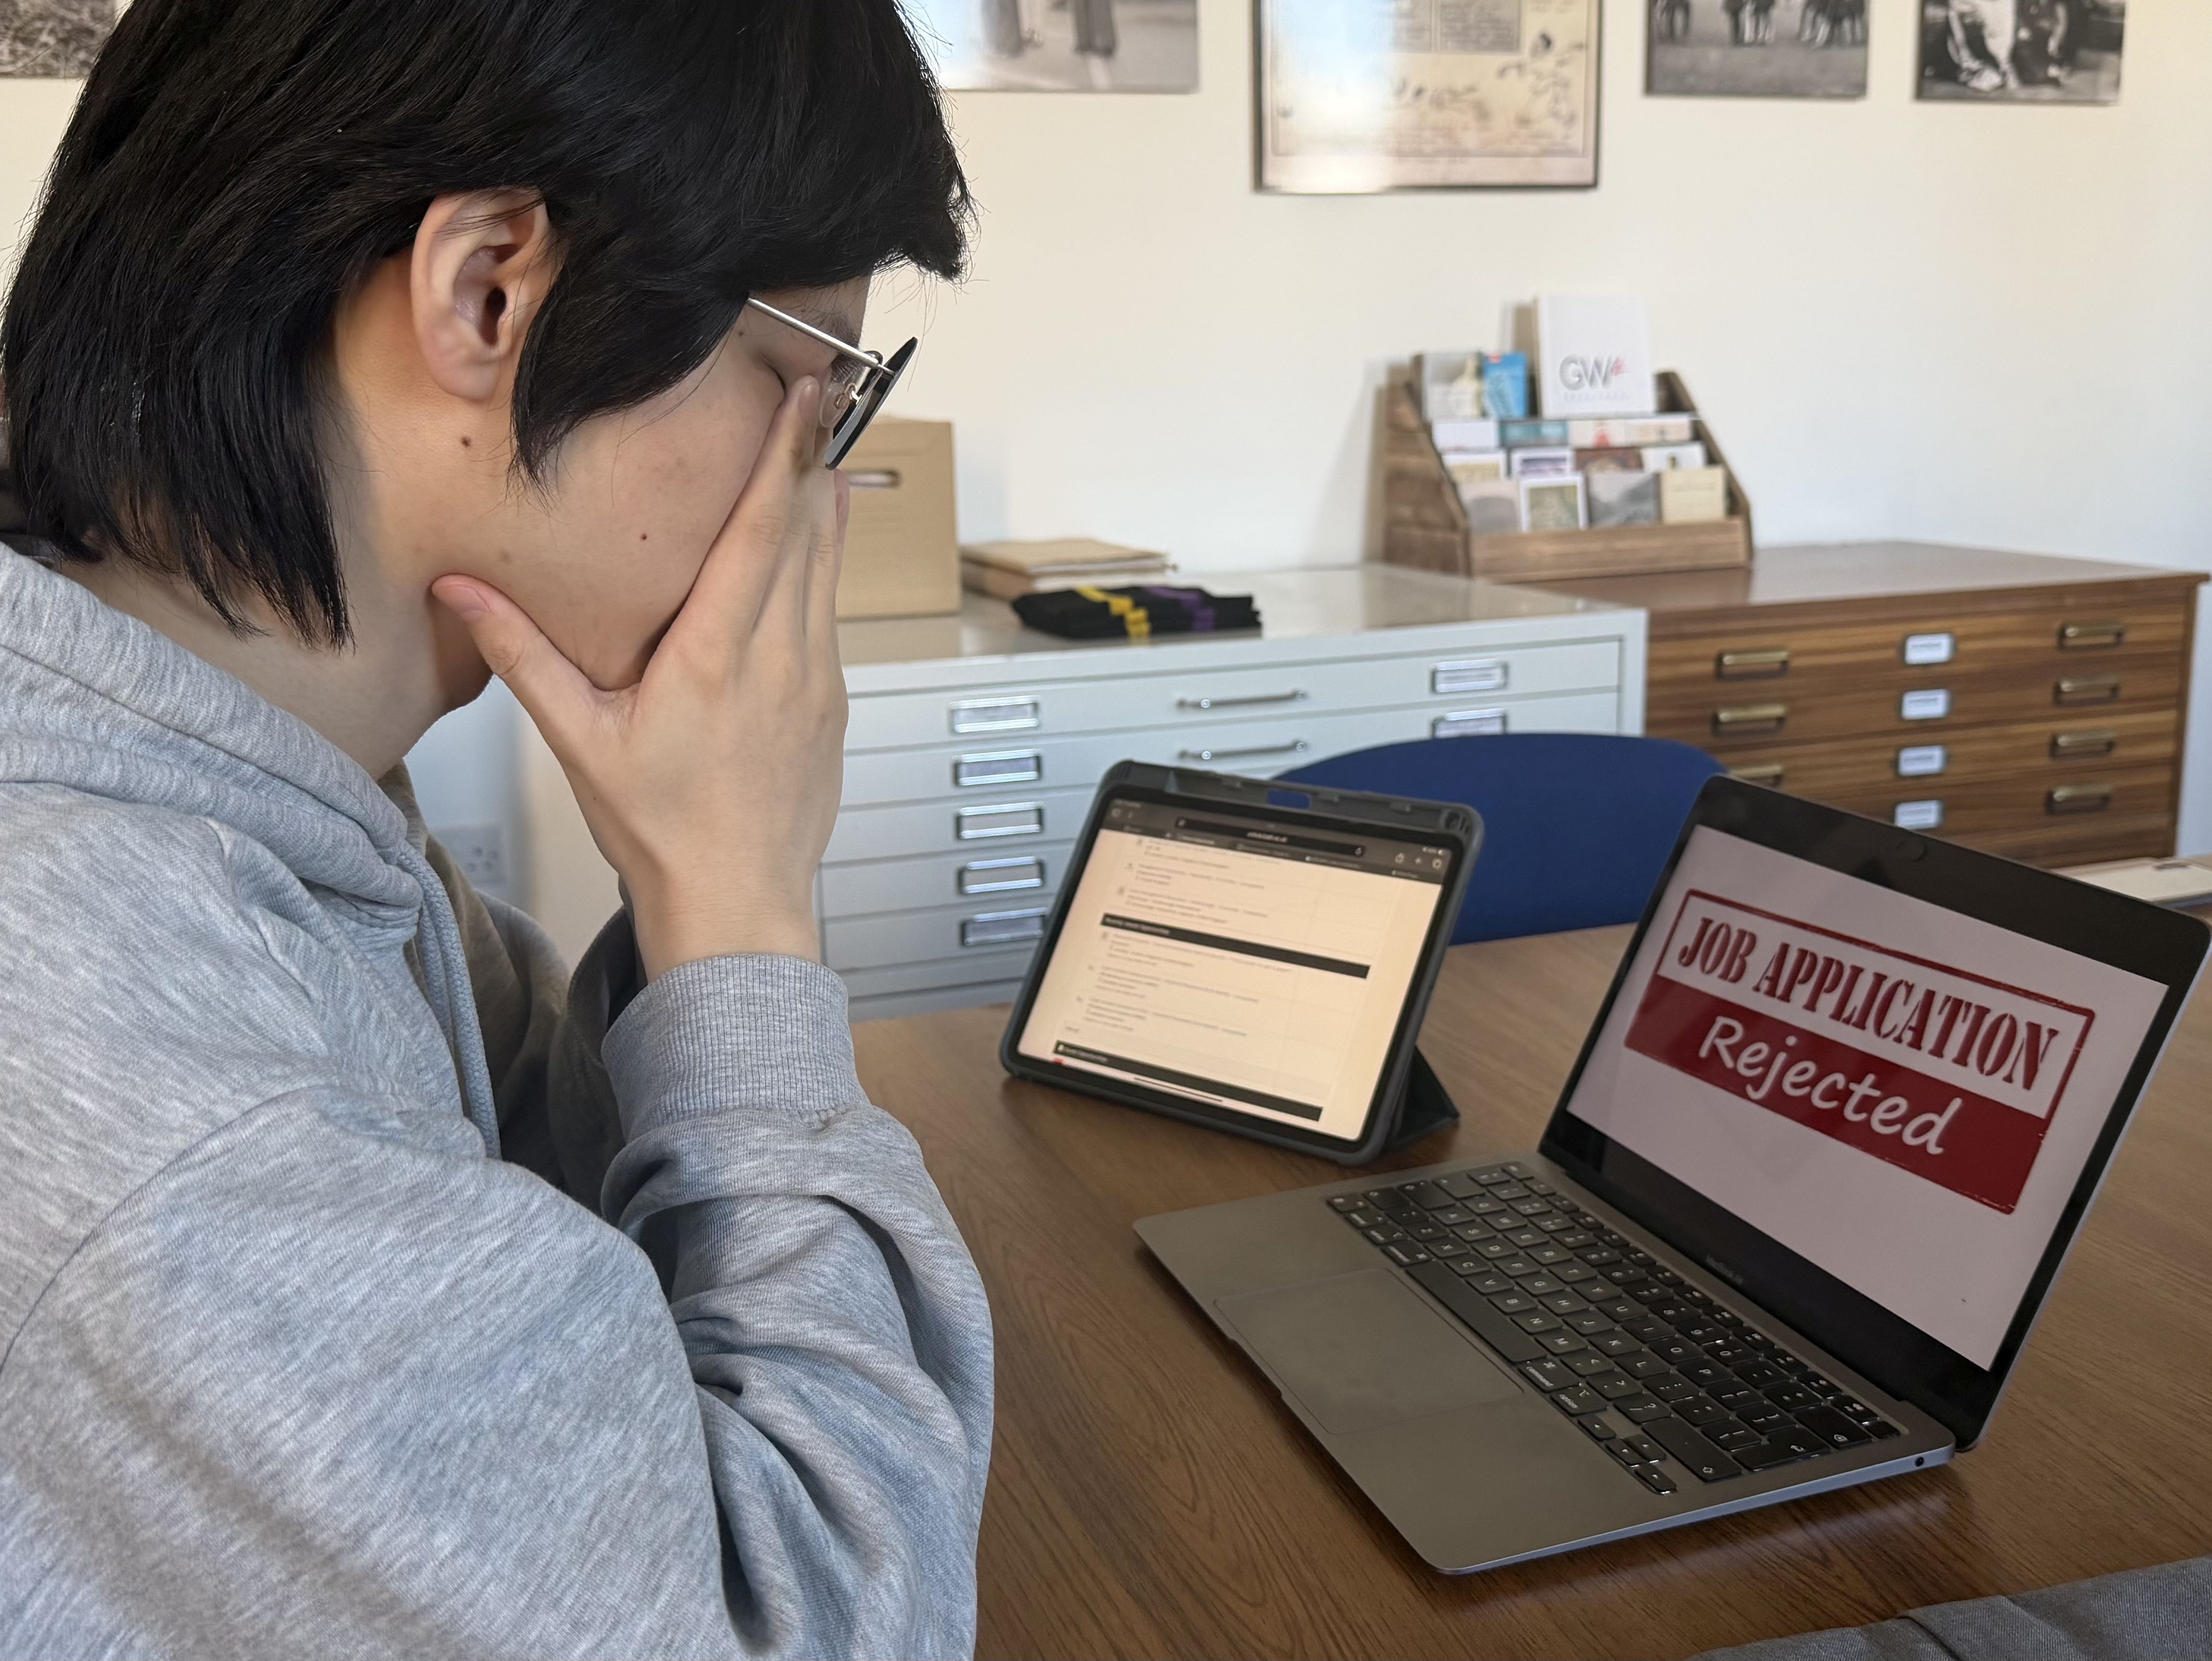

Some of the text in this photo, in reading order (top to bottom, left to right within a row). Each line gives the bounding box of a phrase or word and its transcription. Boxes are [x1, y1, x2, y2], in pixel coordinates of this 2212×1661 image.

[1677, 917, 2060, 1091] JOB APPLICATION
[1698, 1016, 1962, 1155] Rejected
[1526, 1366, 1554, 1386] command
[1559, 1394, 1578, 1409] option
